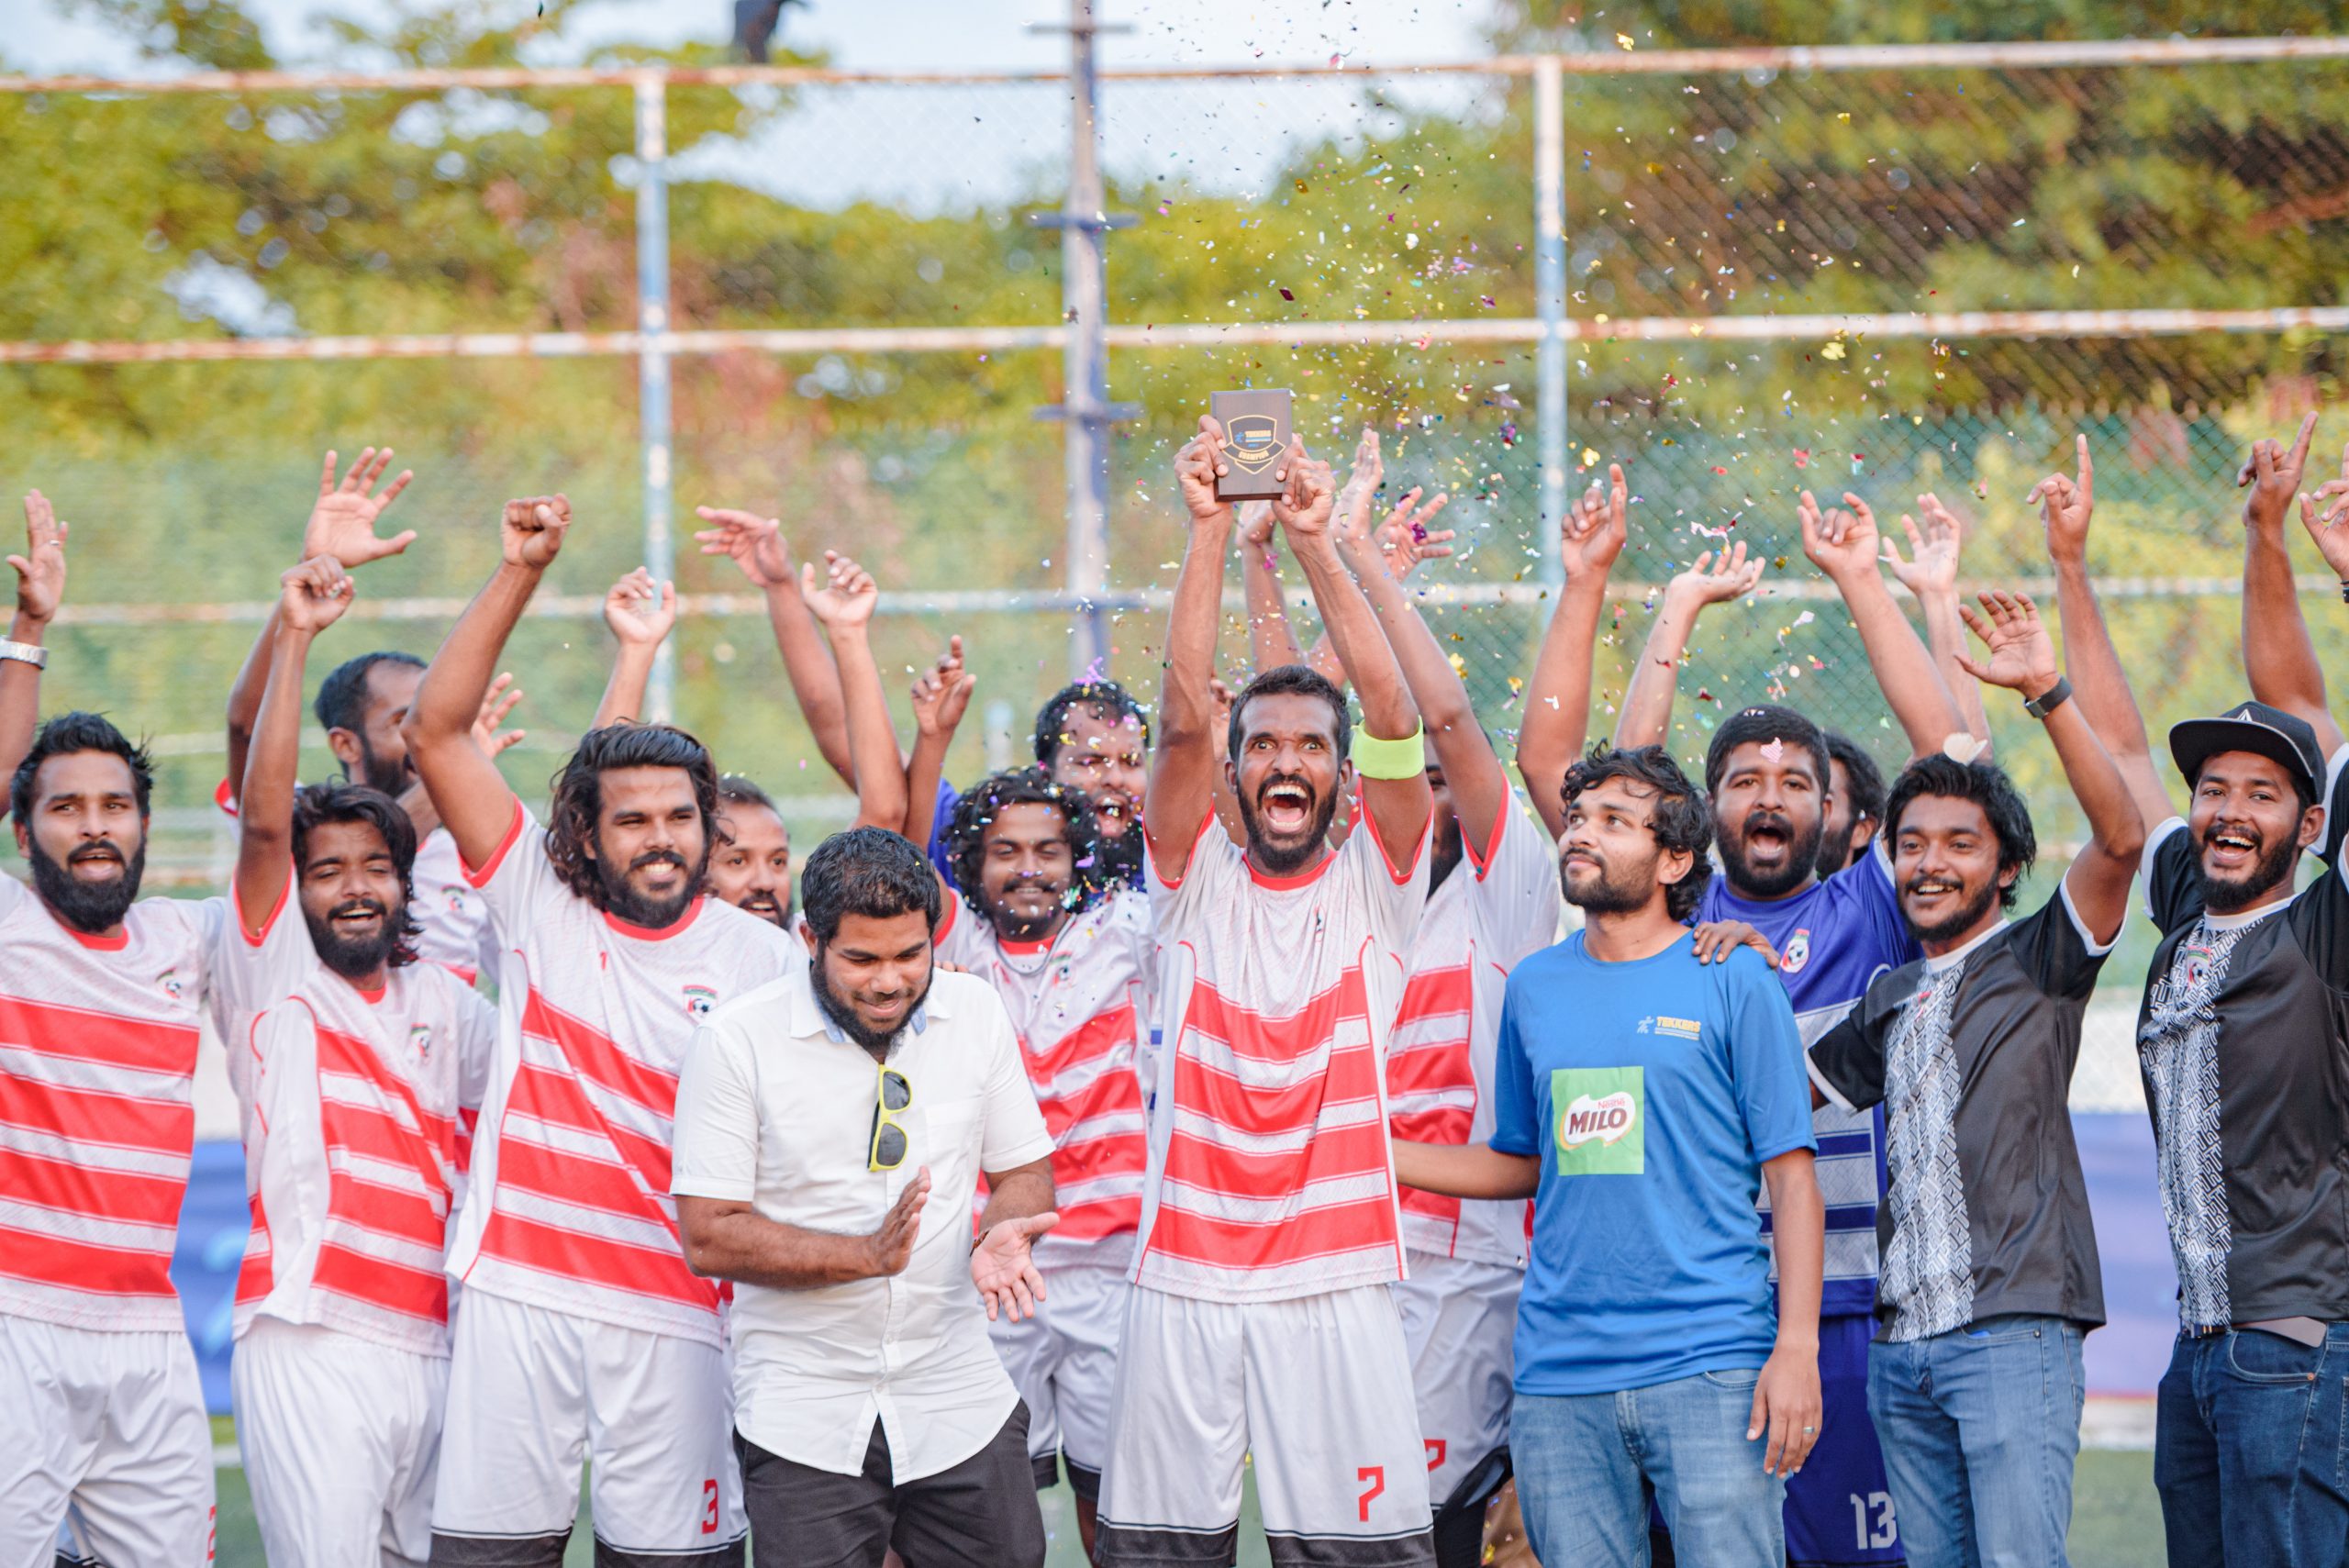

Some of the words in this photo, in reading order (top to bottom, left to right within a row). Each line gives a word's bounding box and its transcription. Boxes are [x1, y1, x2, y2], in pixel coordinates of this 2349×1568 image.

[1656, 1016, 1701, 1033] TEKKERS
[1568, 1107, 1628, 1136] MILO
[702, 1478, 718, 1534] 3
[1357, 1465, 1385, 1522] 7
[1850, 1491, 1898, 1551] 13
